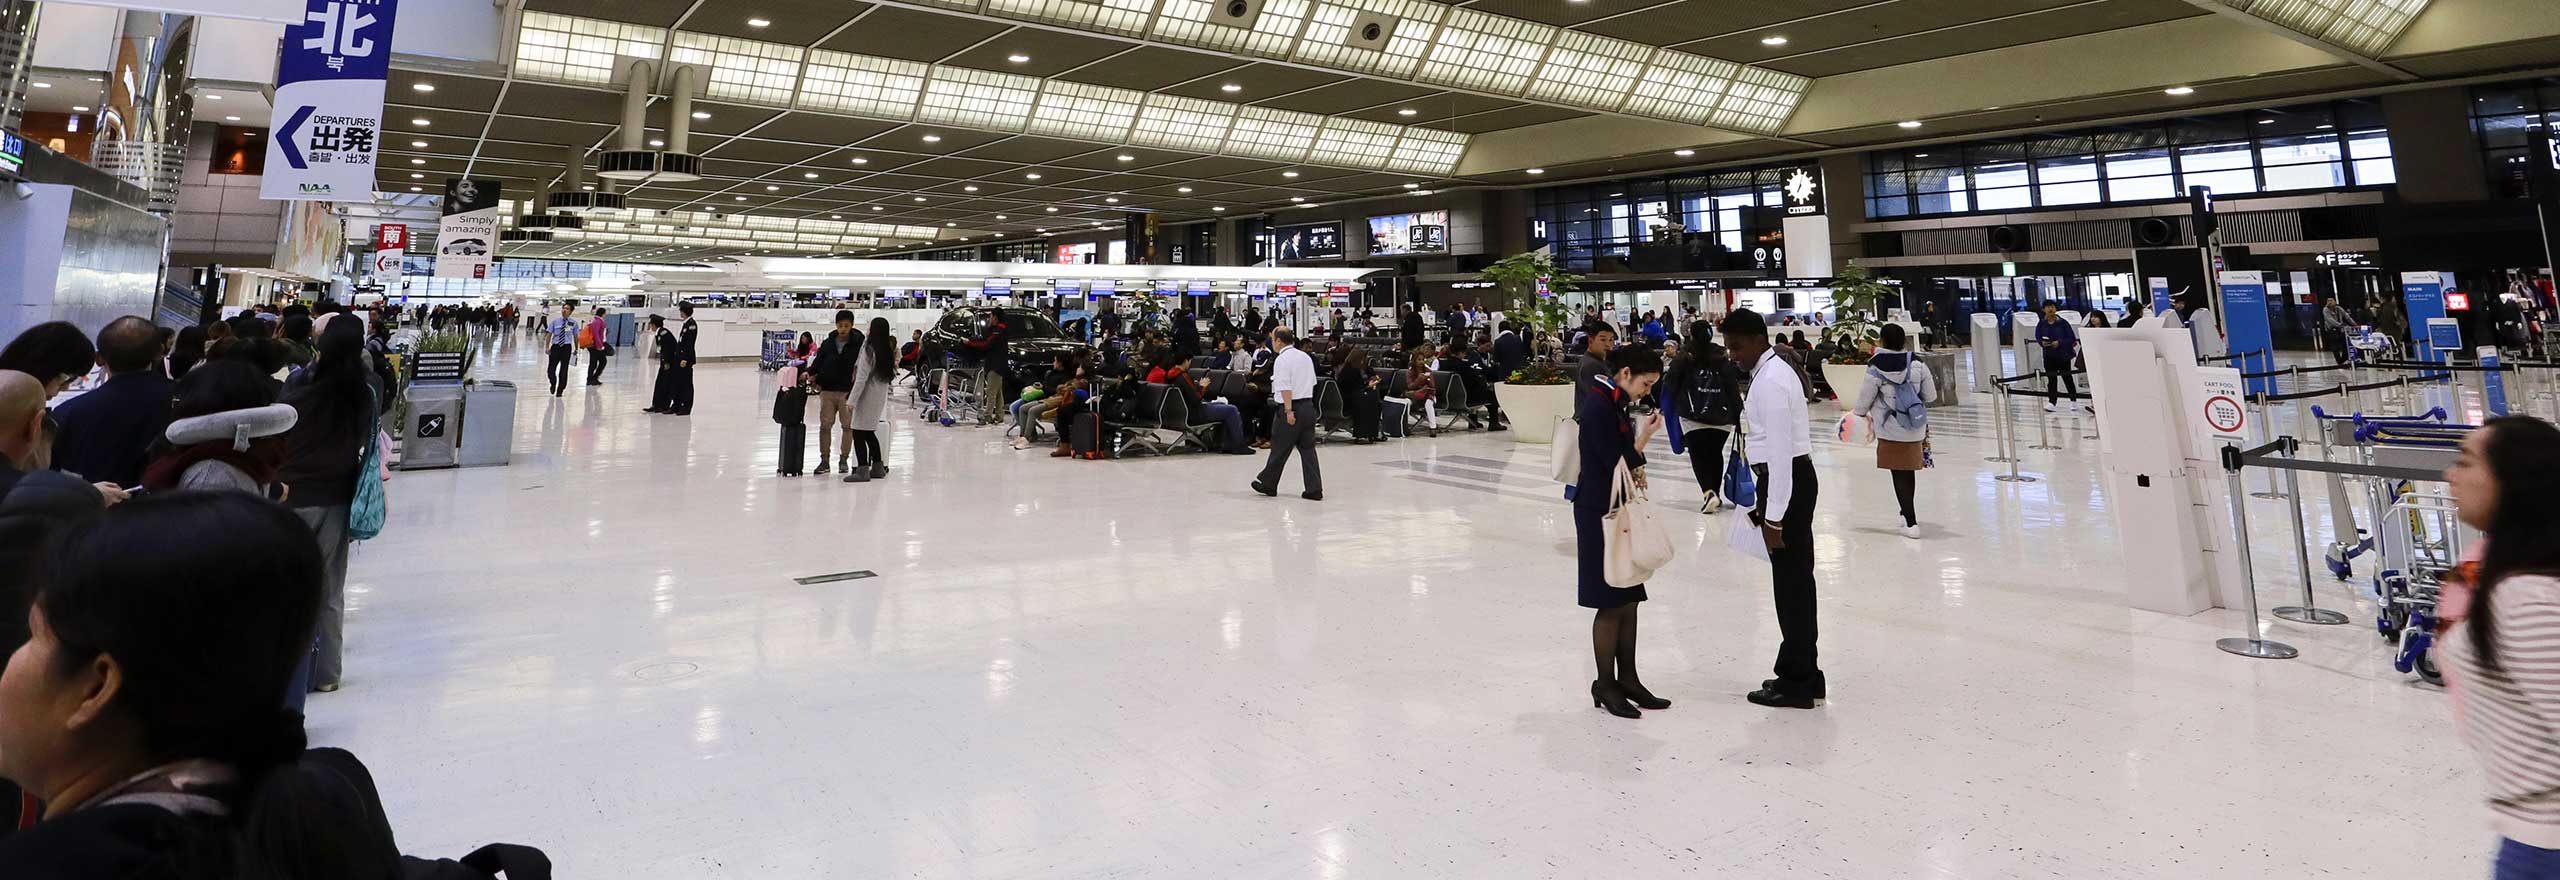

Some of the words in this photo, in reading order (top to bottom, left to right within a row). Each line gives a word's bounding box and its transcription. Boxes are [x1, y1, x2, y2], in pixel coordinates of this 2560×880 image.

[304, 2, 377, 57] 北
[326, 56, 344, 72] 북
[313, 115, 376, 127] DEPARTURES
[310, 125, 374, 153] 出発
[299, 183, 331, 192] NAA
[2203, 190, 2211, 212] F
[1788, 205, 1816, 214] CITIZEN
[459, 216, 495, 226] Simply
[1534, 220, 1546, 238] H
[383, 230, 401, 244] 南
[2326, 254, 2336, 266] F
